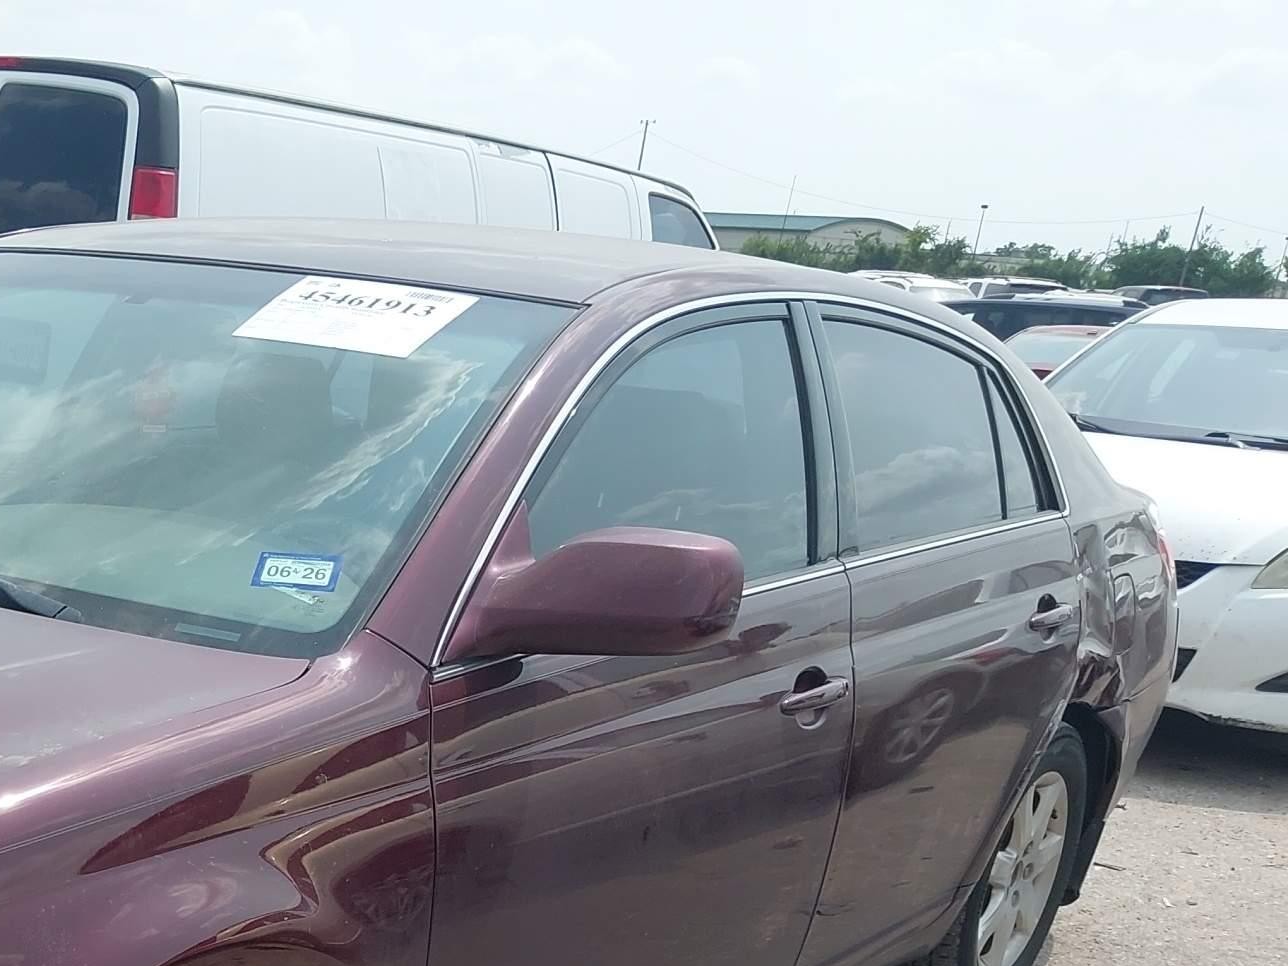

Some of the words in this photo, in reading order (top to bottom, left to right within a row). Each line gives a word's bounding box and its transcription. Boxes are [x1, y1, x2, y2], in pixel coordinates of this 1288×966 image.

[298, 289, 437, 318] 45461913
[266, 565, 292, 578] 06
[301, 567, 327, 581] 26
